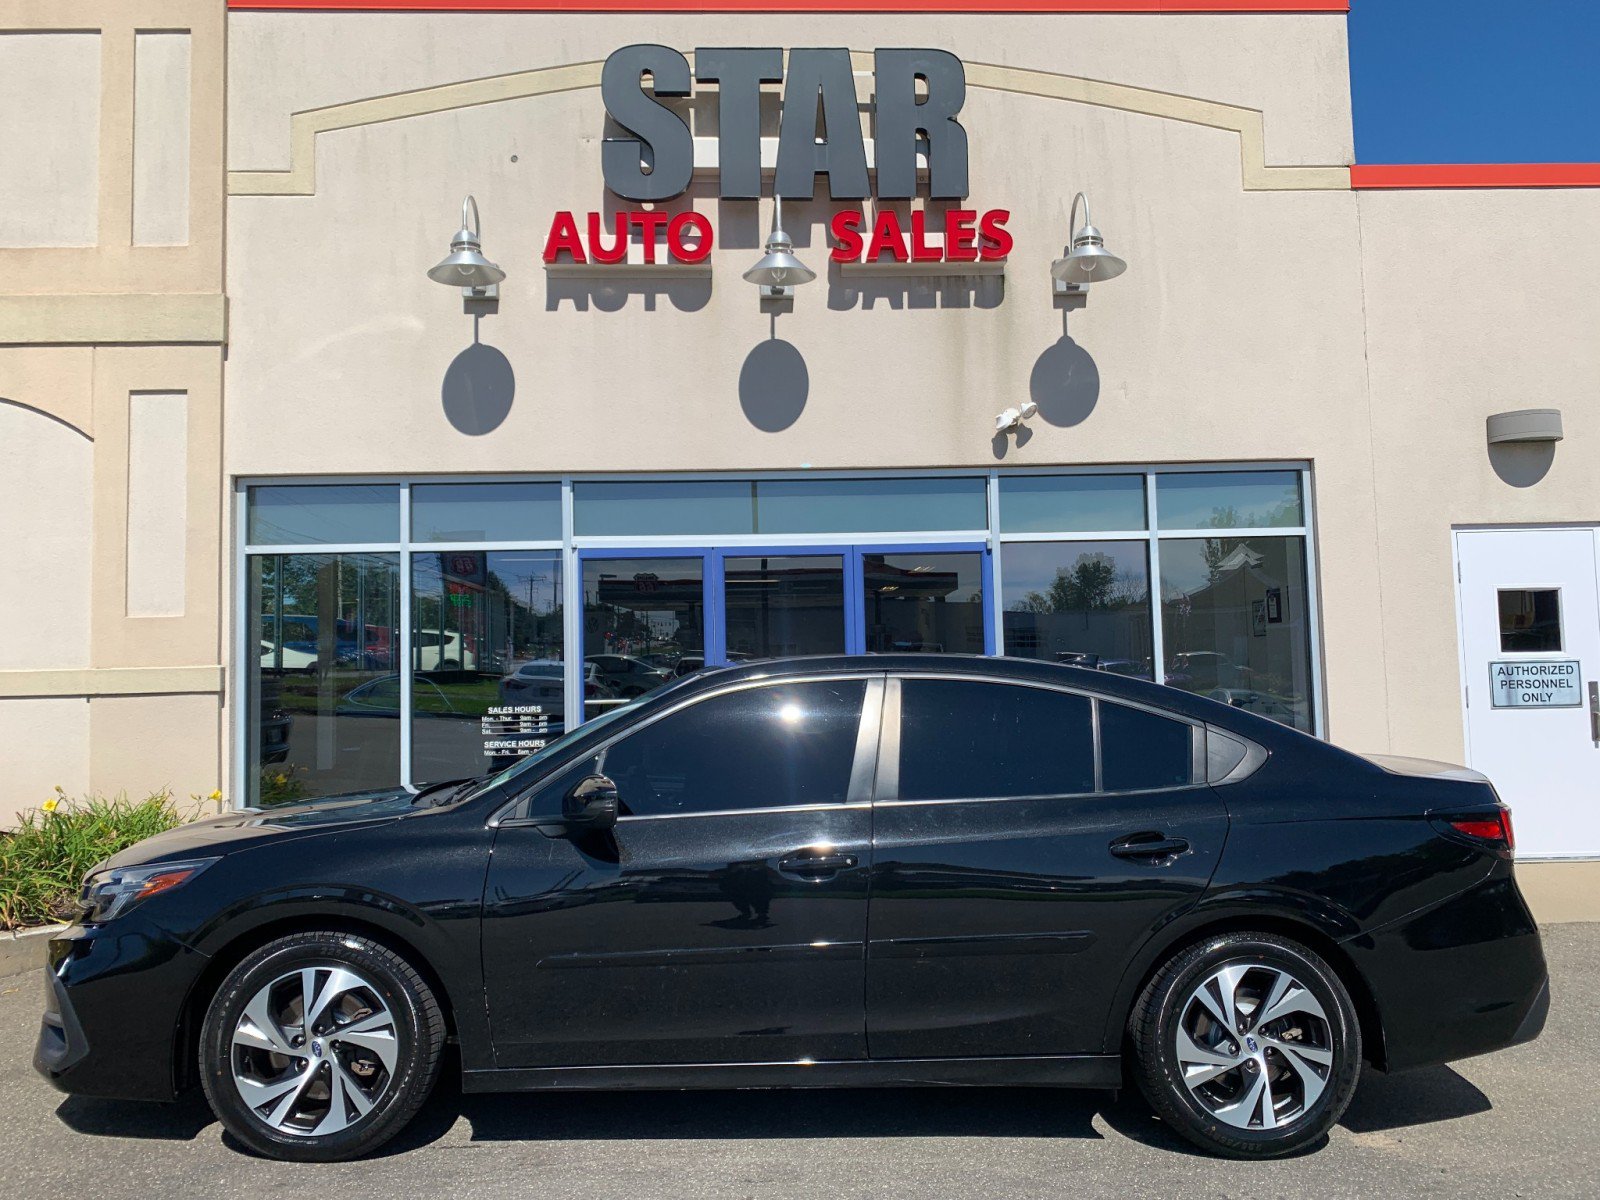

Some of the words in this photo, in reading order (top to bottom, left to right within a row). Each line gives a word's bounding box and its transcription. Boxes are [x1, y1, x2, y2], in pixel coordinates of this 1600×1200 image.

[601, 43, 969, 201] STAR
[542, 211, 714, 264] AUTO
[830, 209, 1014, 264] SALES
[1497, 665, 1574, 676] AUTHORIZED
[1500, 679, 1573, 689] PERSONNEL
[1522, 692, 1553, 702] ONLY
